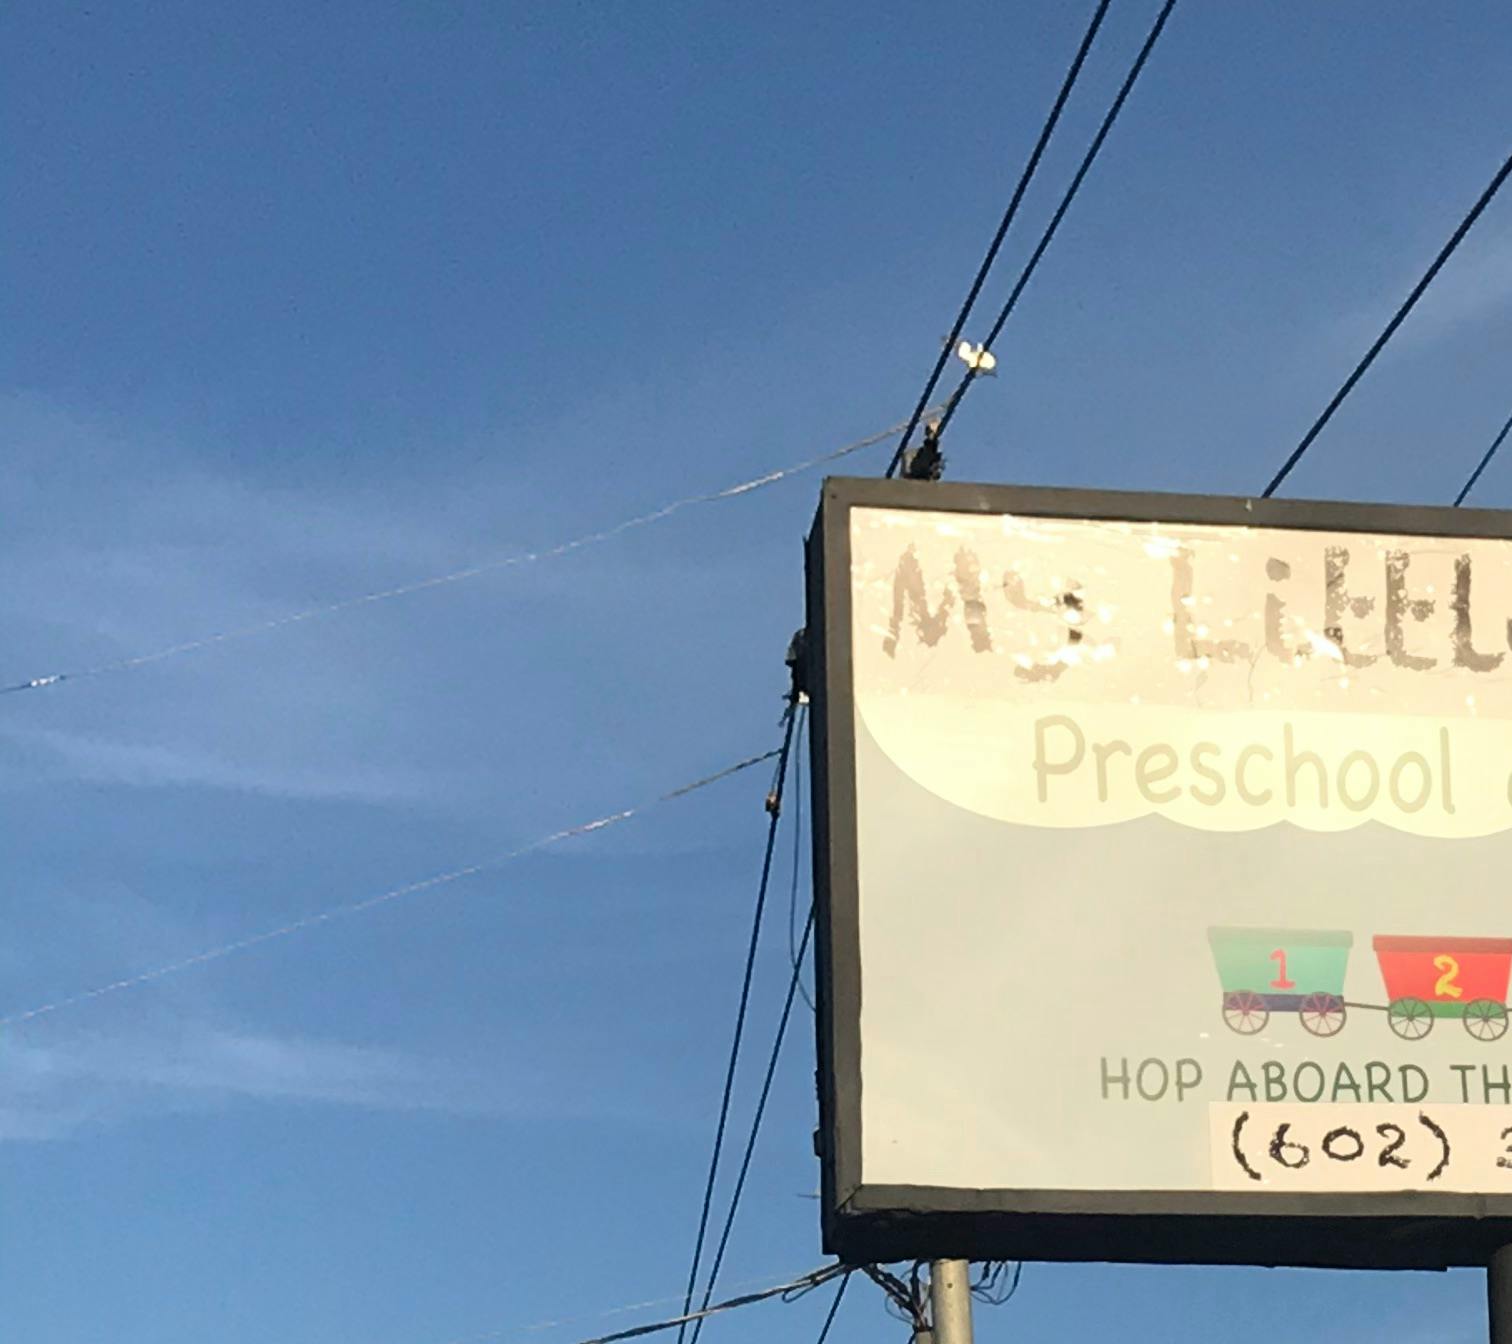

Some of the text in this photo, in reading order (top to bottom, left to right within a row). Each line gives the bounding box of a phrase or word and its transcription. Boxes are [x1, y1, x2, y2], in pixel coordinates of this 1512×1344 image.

[1032, 713, 1456, 815] Preschool
[1269, 948, 1296, 990] 1
[1432, 953, 1464, 998] 2
[1100, 1056, 1203, 1103] HOP
[1226, 1058, 1429, 1105] ABOARD
[1231, 1109, 1452, 1182] (602)
